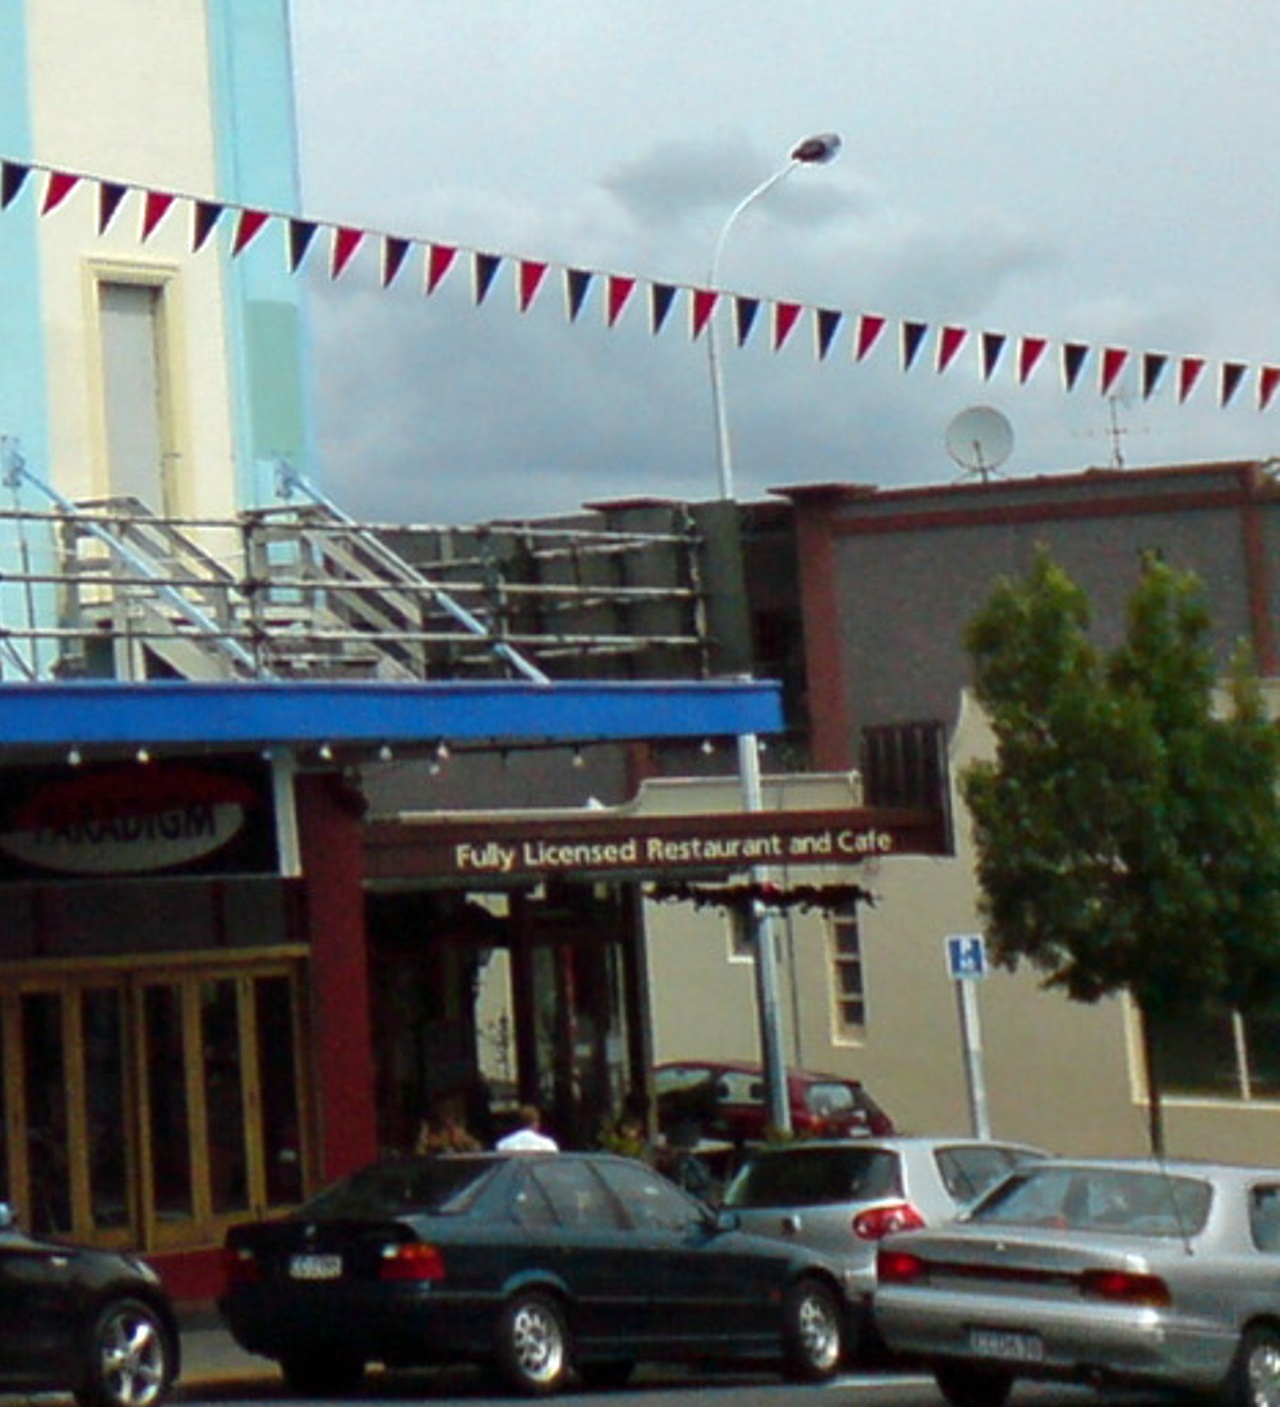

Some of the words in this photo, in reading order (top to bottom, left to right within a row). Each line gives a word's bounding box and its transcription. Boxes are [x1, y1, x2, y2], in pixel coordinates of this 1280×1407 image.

[456, 841, 515, 873] Fully
[522, 837, 637, 866] Licensed
[646, 833, 783, 861] Restaurant
[790, 830, 832, 855] and
[838, 828, 893, 853] Cafe
